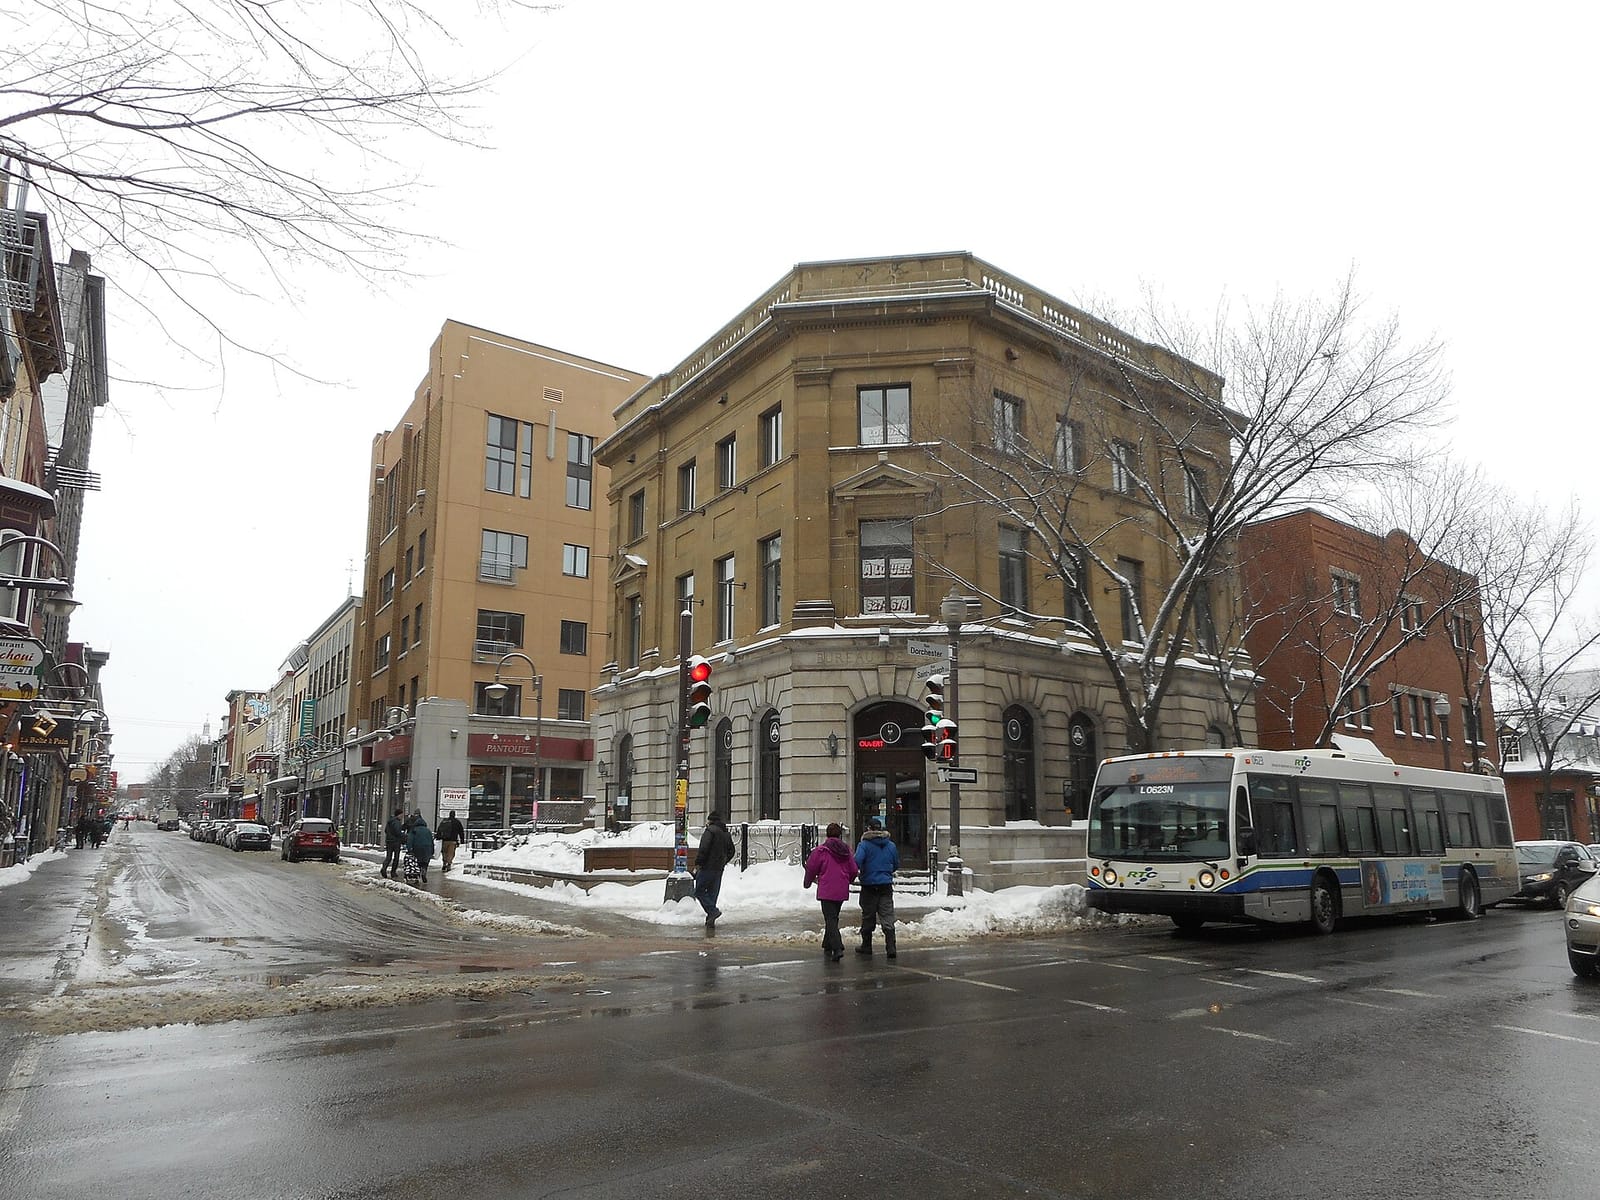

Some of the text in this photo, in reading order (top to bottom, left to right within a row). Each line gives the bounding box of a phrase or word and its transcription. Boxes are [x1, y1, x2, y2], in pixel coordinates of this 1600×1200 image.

[910, 647, 943, 657] Dorchester
[815, 652, 874, 665] BUREAU
[53, 737, 69, 745] Pain
[486, 744, 531, 753] PANTOUTE
[1294, 758, 1312, 767] RTC
[1127, 871, 1158, 879] RTC
